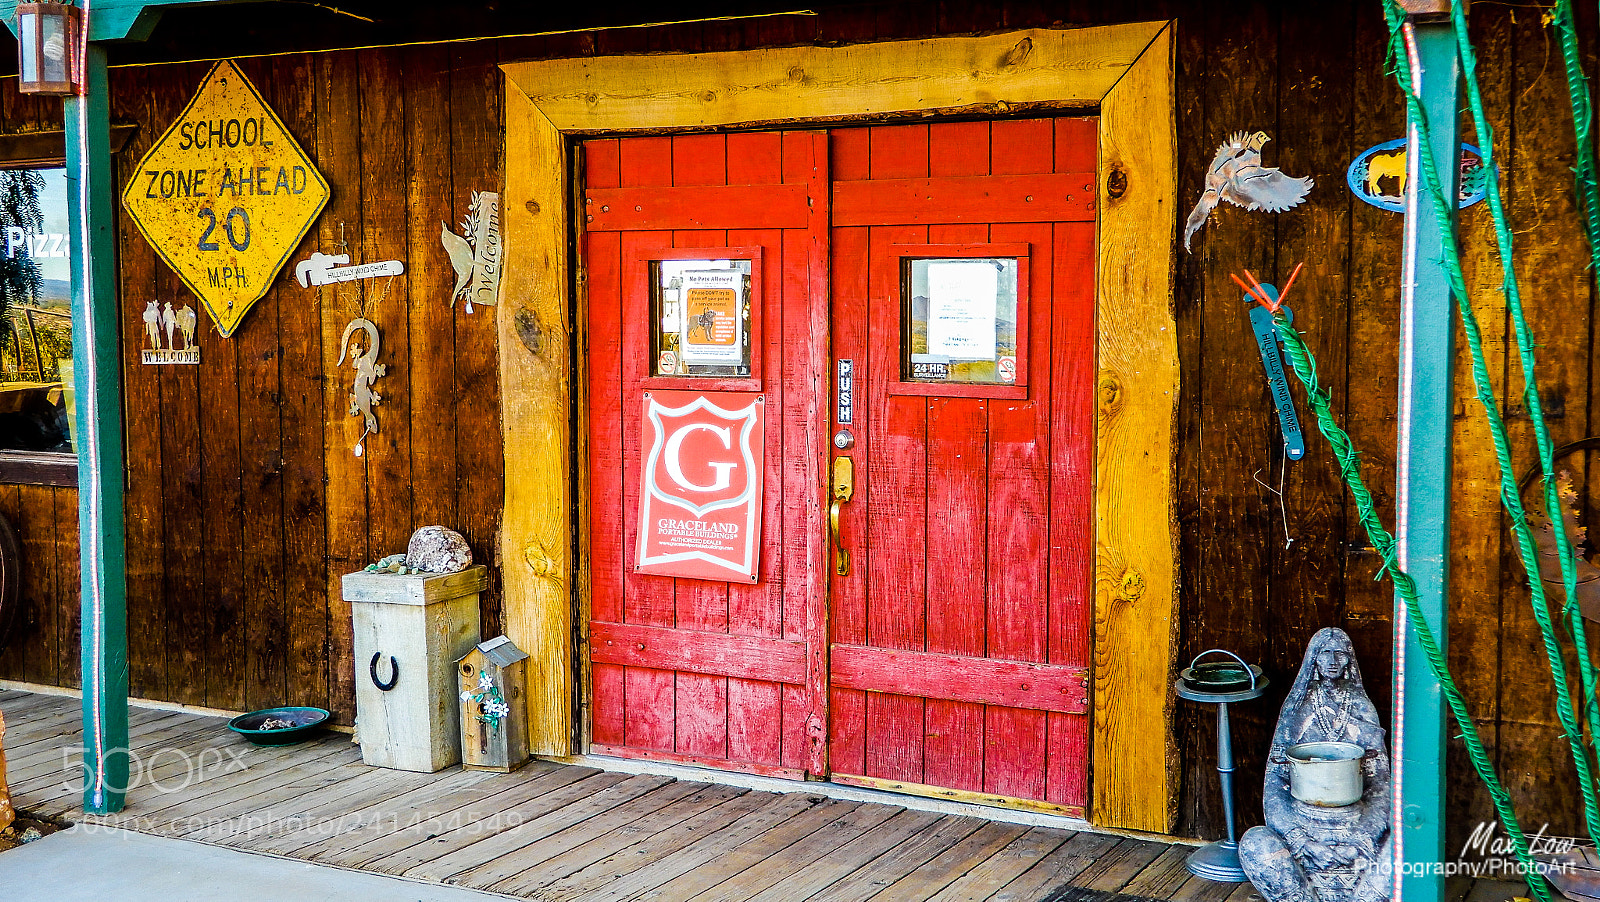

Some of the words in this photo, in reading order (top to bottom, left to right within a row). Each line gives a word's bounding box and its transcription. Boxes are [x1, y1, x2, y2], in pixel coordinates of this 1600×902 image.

[179, 117, 274, 150] SCHOOL
[145, 168, 207, 199] ZONE
[219, 165, 307, 197] AHEAD
[6, 226, 71, 258] Pizz
[197, 207, 251, 252] 20
[477, 202, 499, 298] Welcome
[370, 263, 388, 272] CHIME
[143, 350, 199, 363] WELCOME
[913, 363, 928, 373] 24
[840, 362, 851, 421] PUSH
[1261, 333, 1282, 376] HILLBILLY
[1275, 375, 1287, 403] WIND
[1282, 402, 1297, 433] CHIME
[664, 423, 738, 492] G
[658, 518, 739, 534] GRACELAND
[658, 528, 694, 537] PORTABLE
